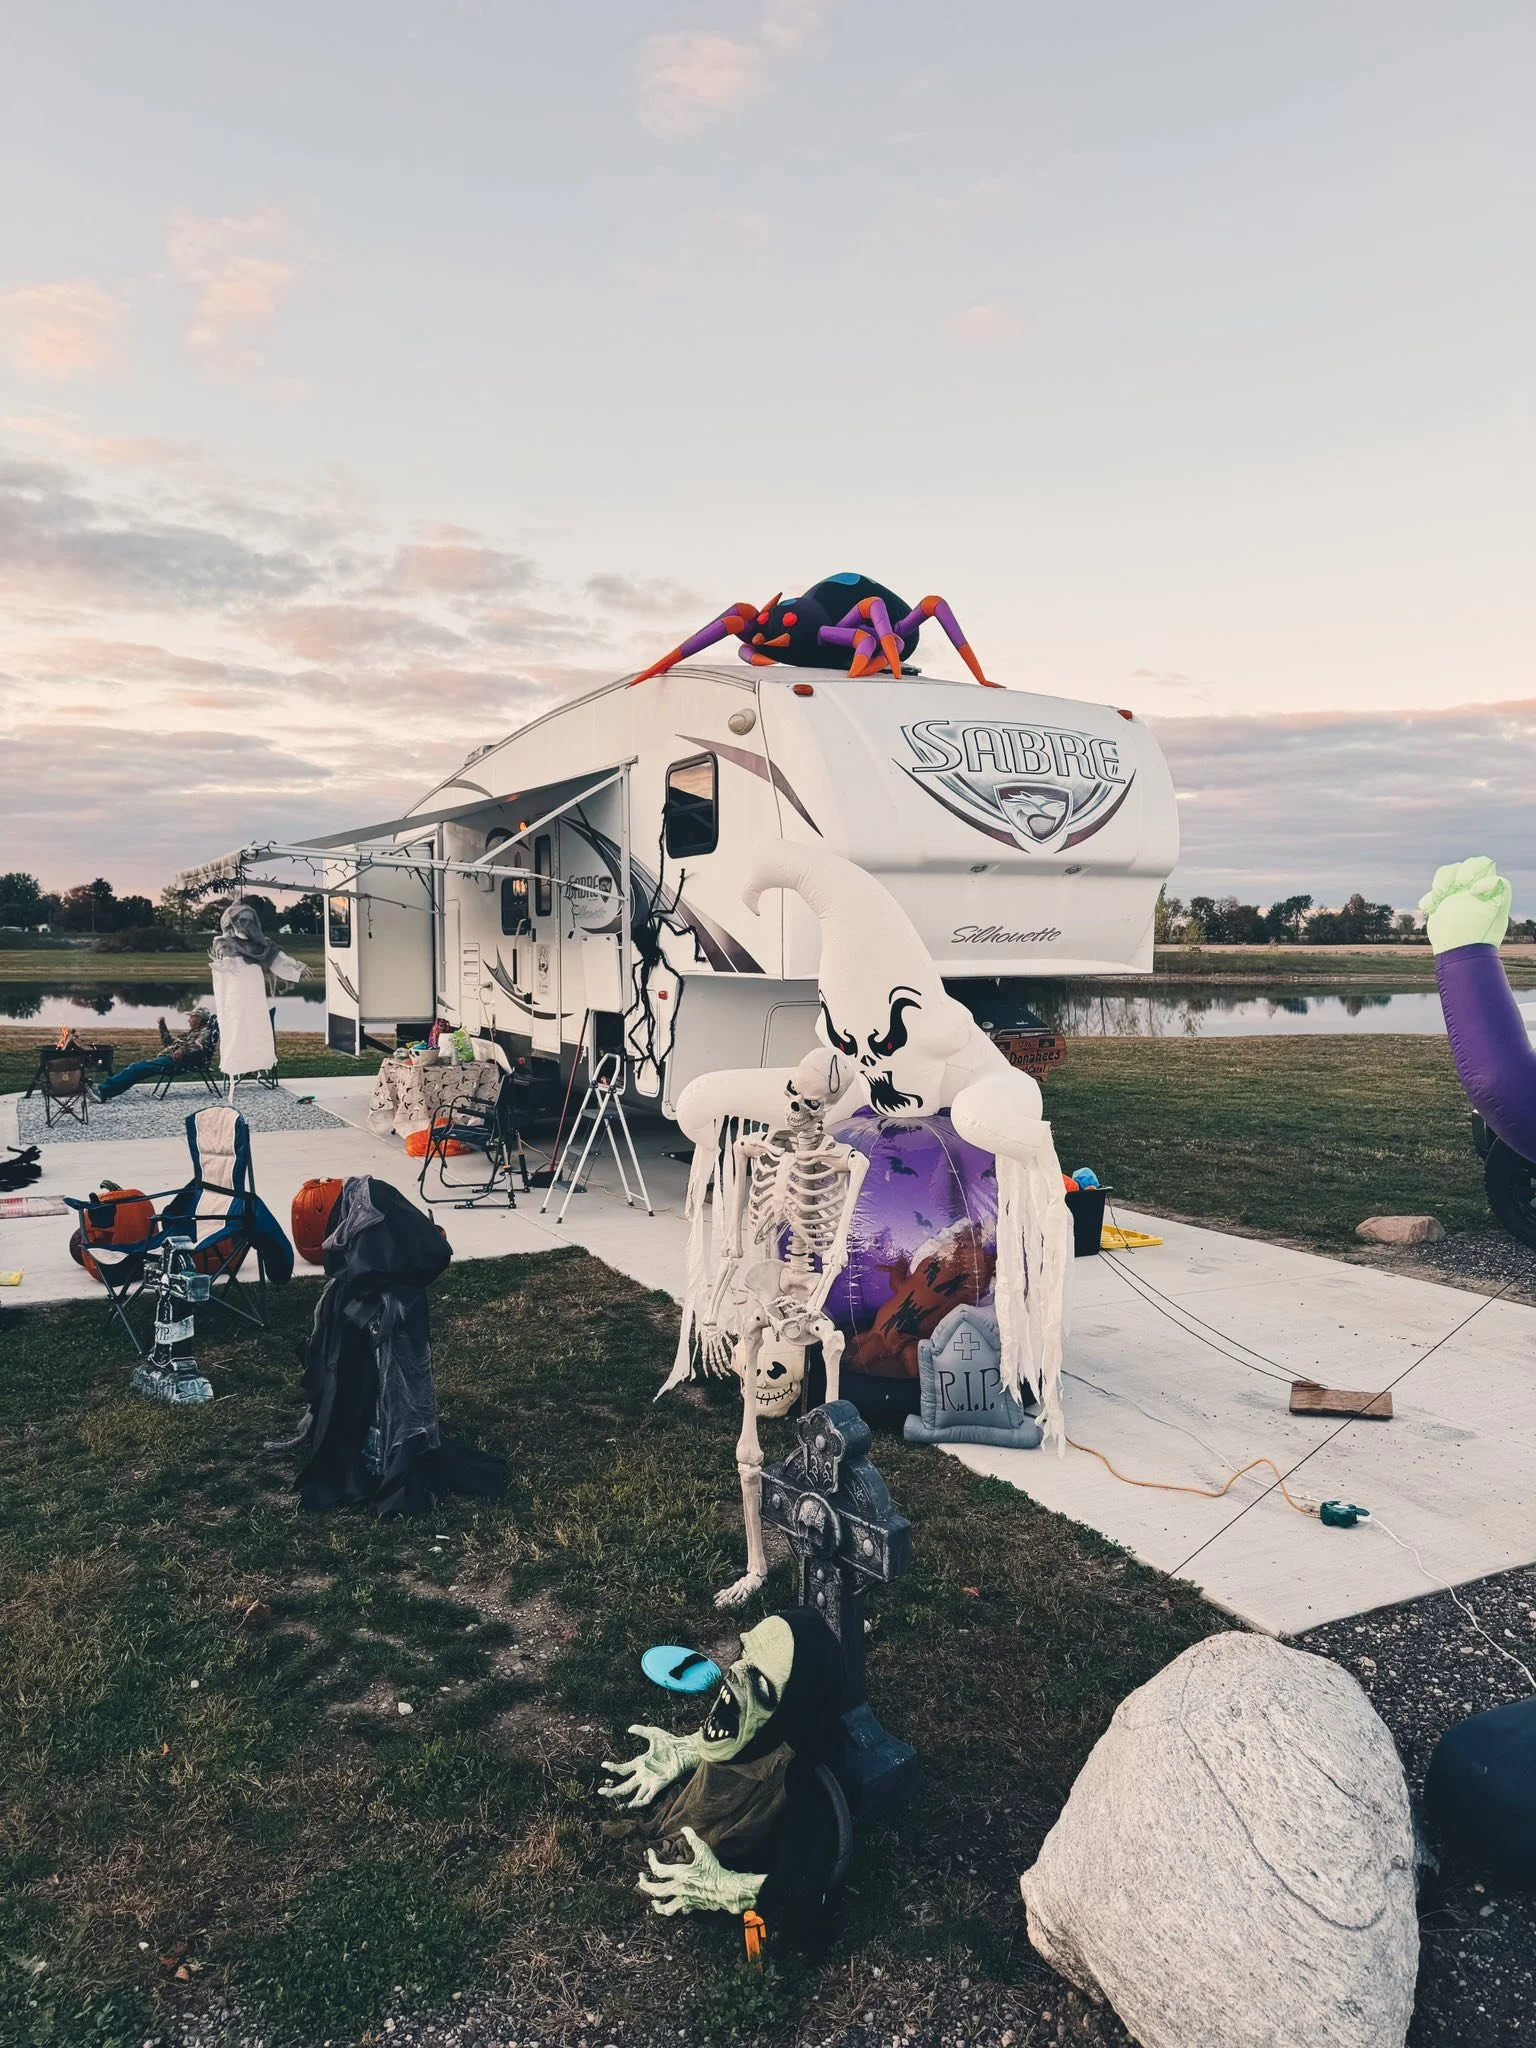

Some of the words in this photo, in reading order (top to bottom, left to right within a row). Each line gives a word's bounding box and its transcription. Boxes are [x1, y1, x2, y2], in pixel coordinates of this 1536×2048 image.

[912, 720, 1126, 784] SABRE
[951, 925, 1062, 943] Silhouette
[1009, 1050, 1061, 1066] Donahees
